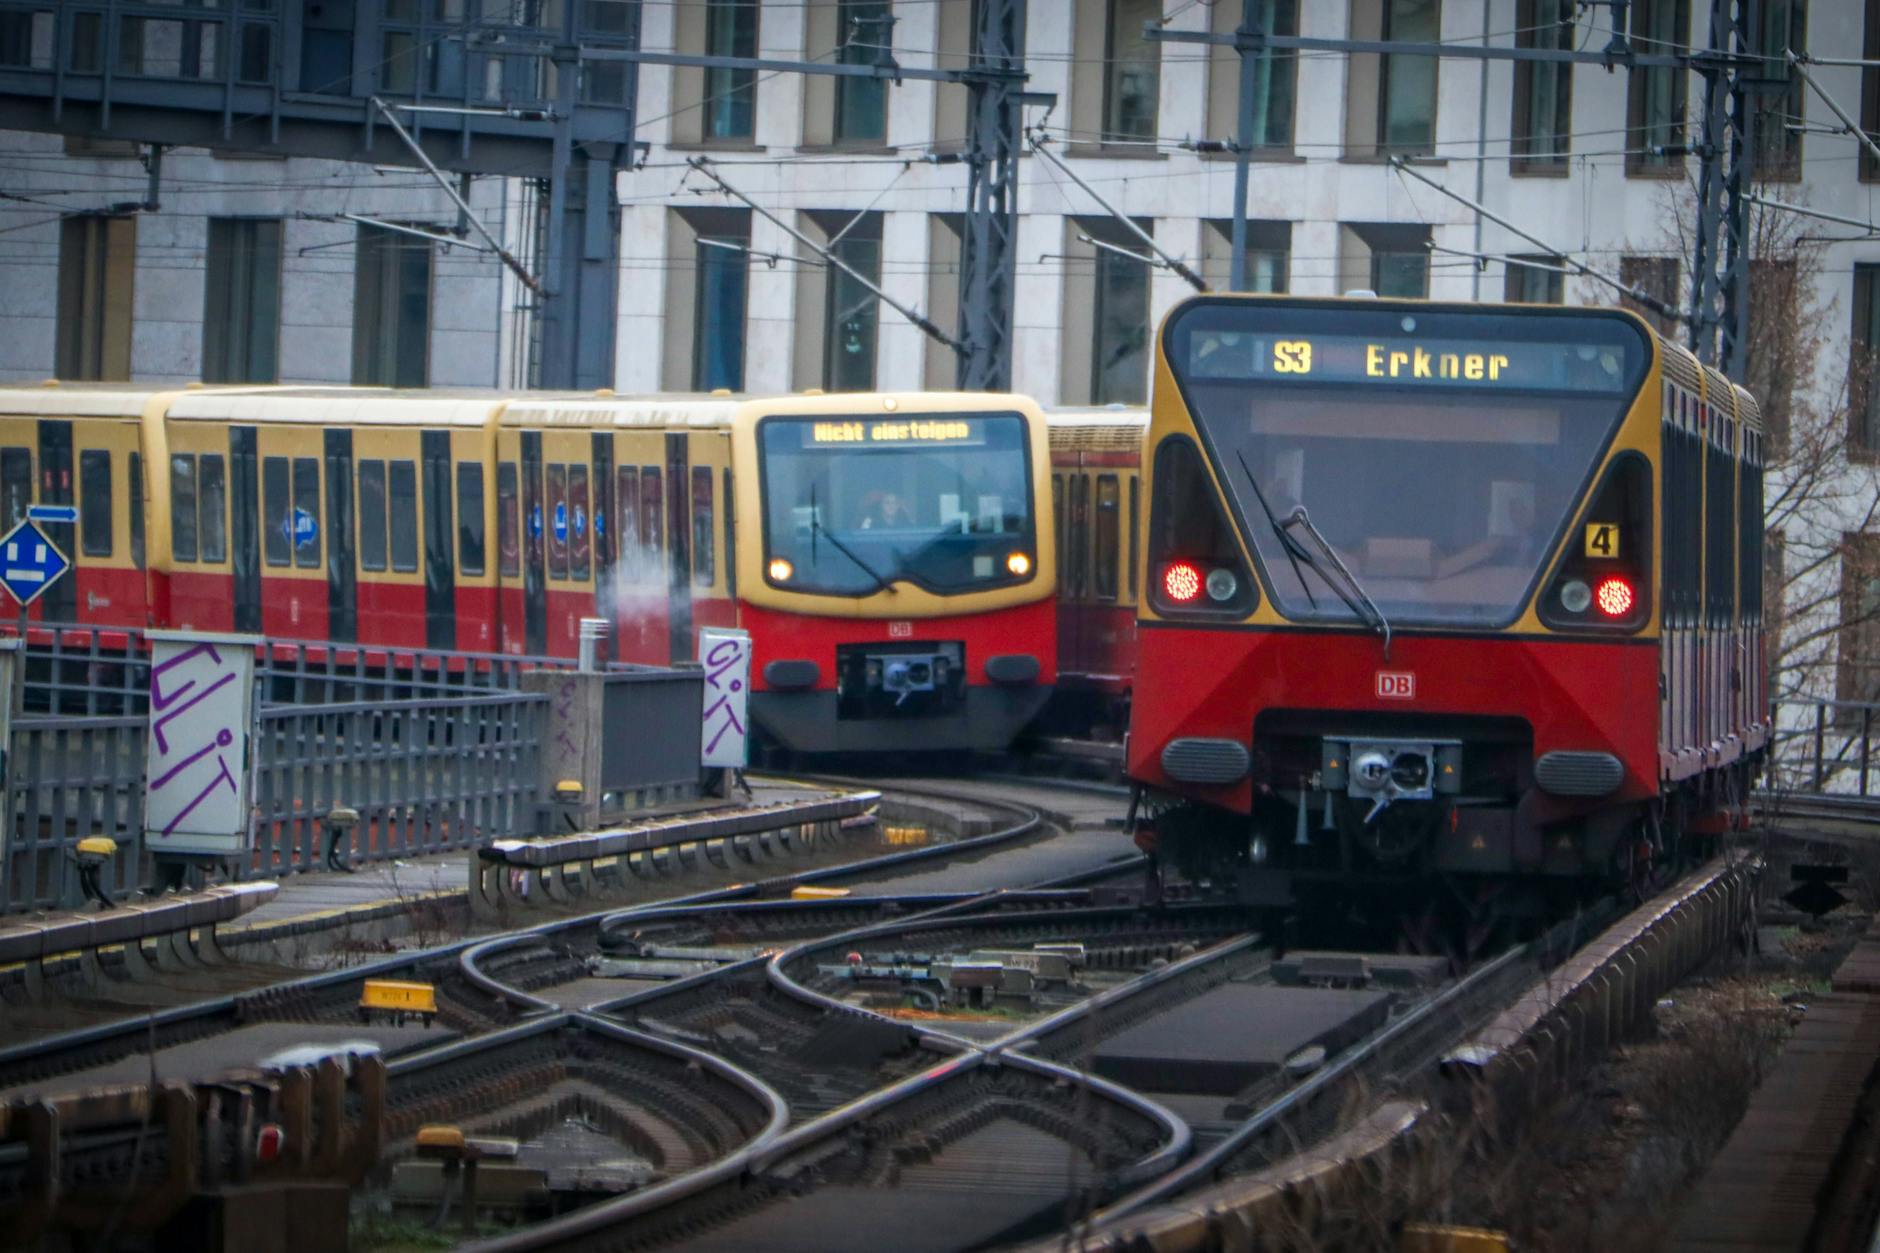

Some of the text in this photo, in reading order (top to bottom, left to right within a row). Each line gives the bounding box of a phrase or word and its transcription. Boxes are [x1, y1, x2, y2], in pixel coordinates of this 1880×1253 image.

[1273, 340, 1509, 380] S3 Erkner
[814, 420, 969, 442] Nicht einsteigen
[1591, 526, 1612, 555] 4
[1379, 675, 1411, 695] DB
